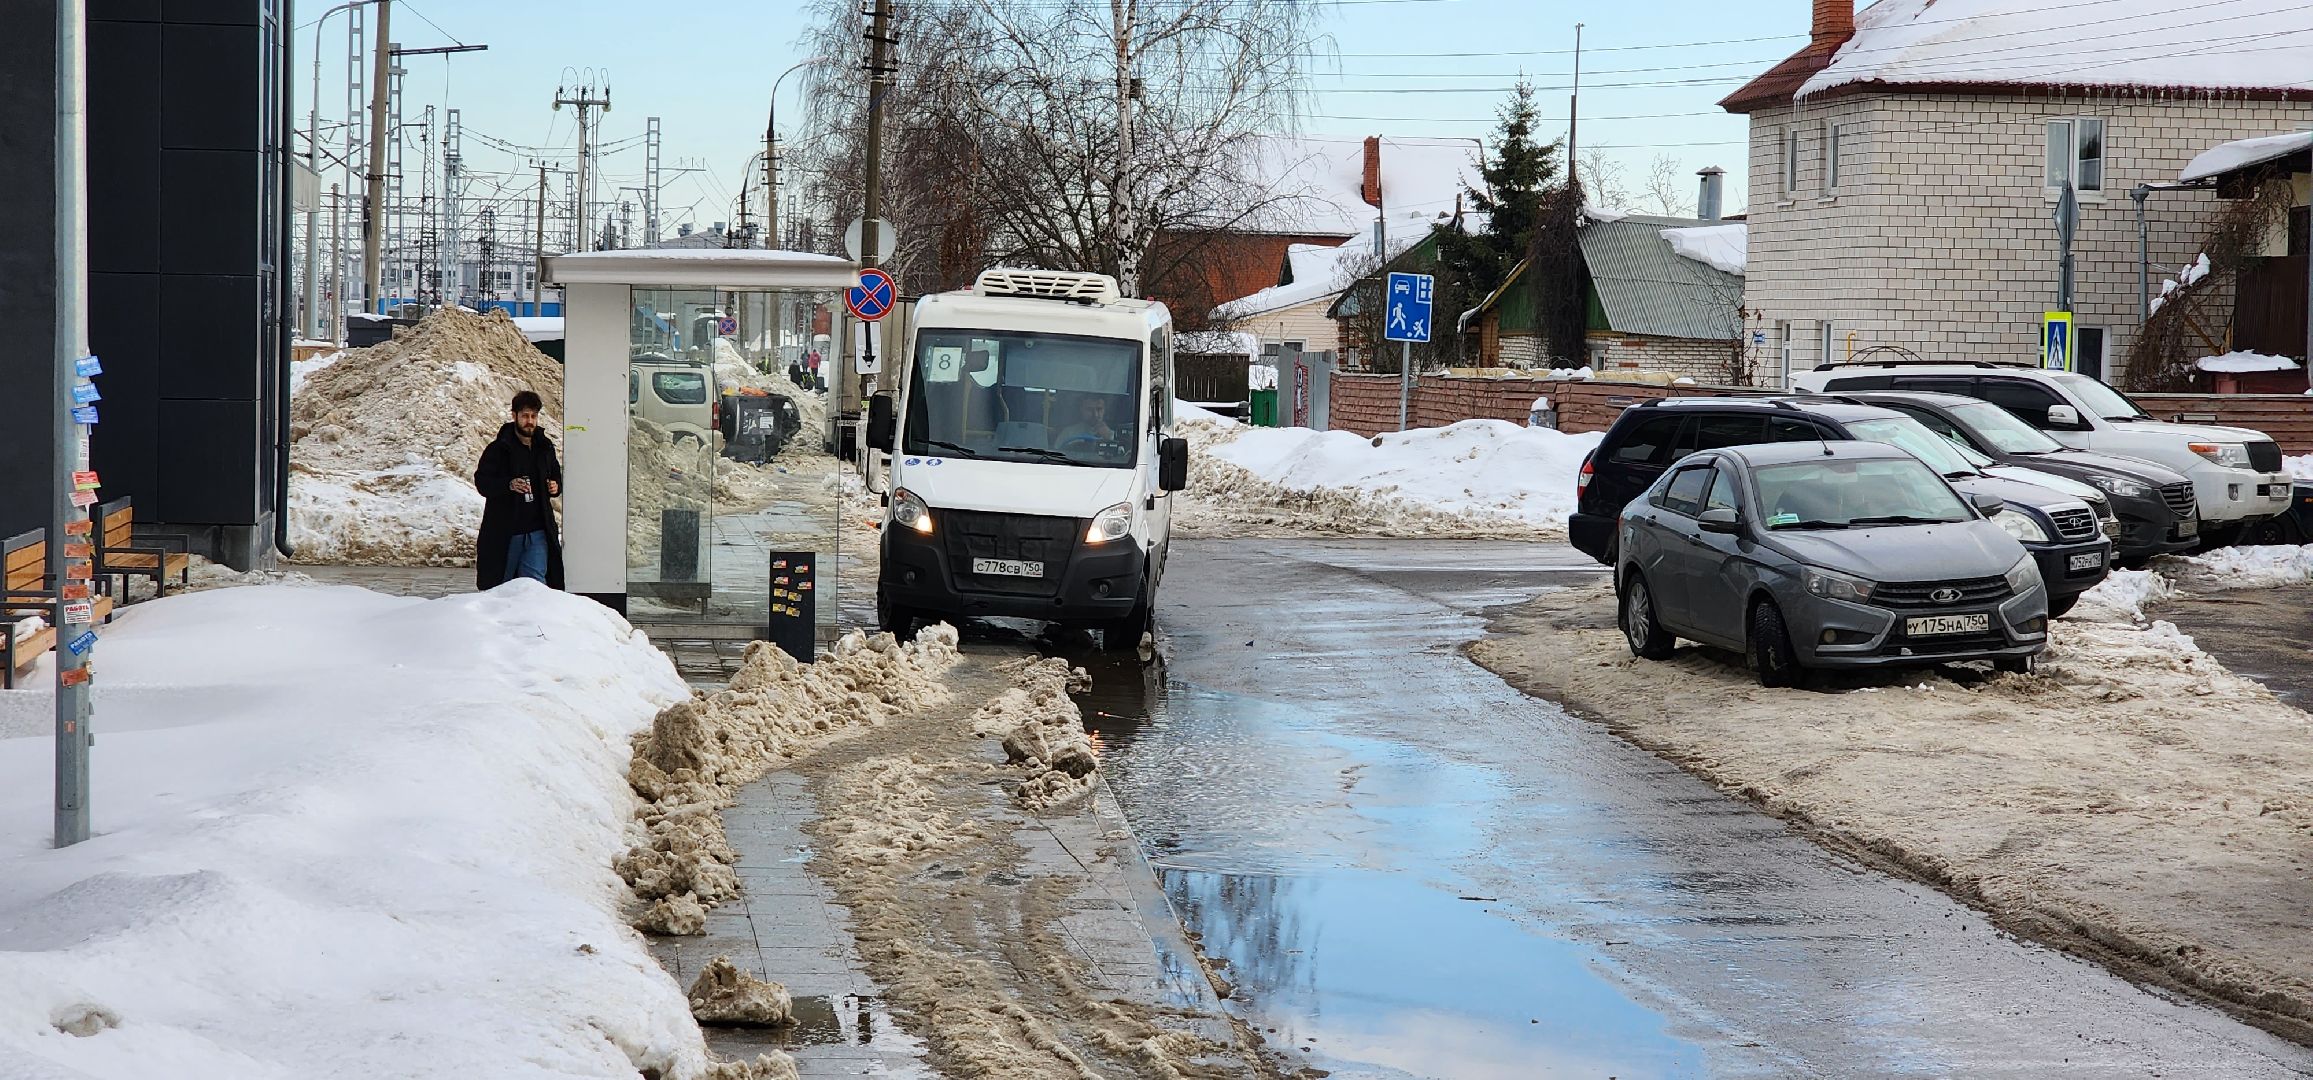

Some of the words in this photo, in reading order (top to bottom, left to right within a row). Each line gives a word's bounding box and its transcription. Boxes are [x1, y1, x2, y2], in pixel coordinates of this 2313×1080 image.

[939, 353, 951, 370] 8
[976, 561, 1021, 574] С778СВ
[1023, 562, 1041, 572] 750
[1912, 618, 1963, 634] У175НА
[1965, 615, 1985, 626] 750
